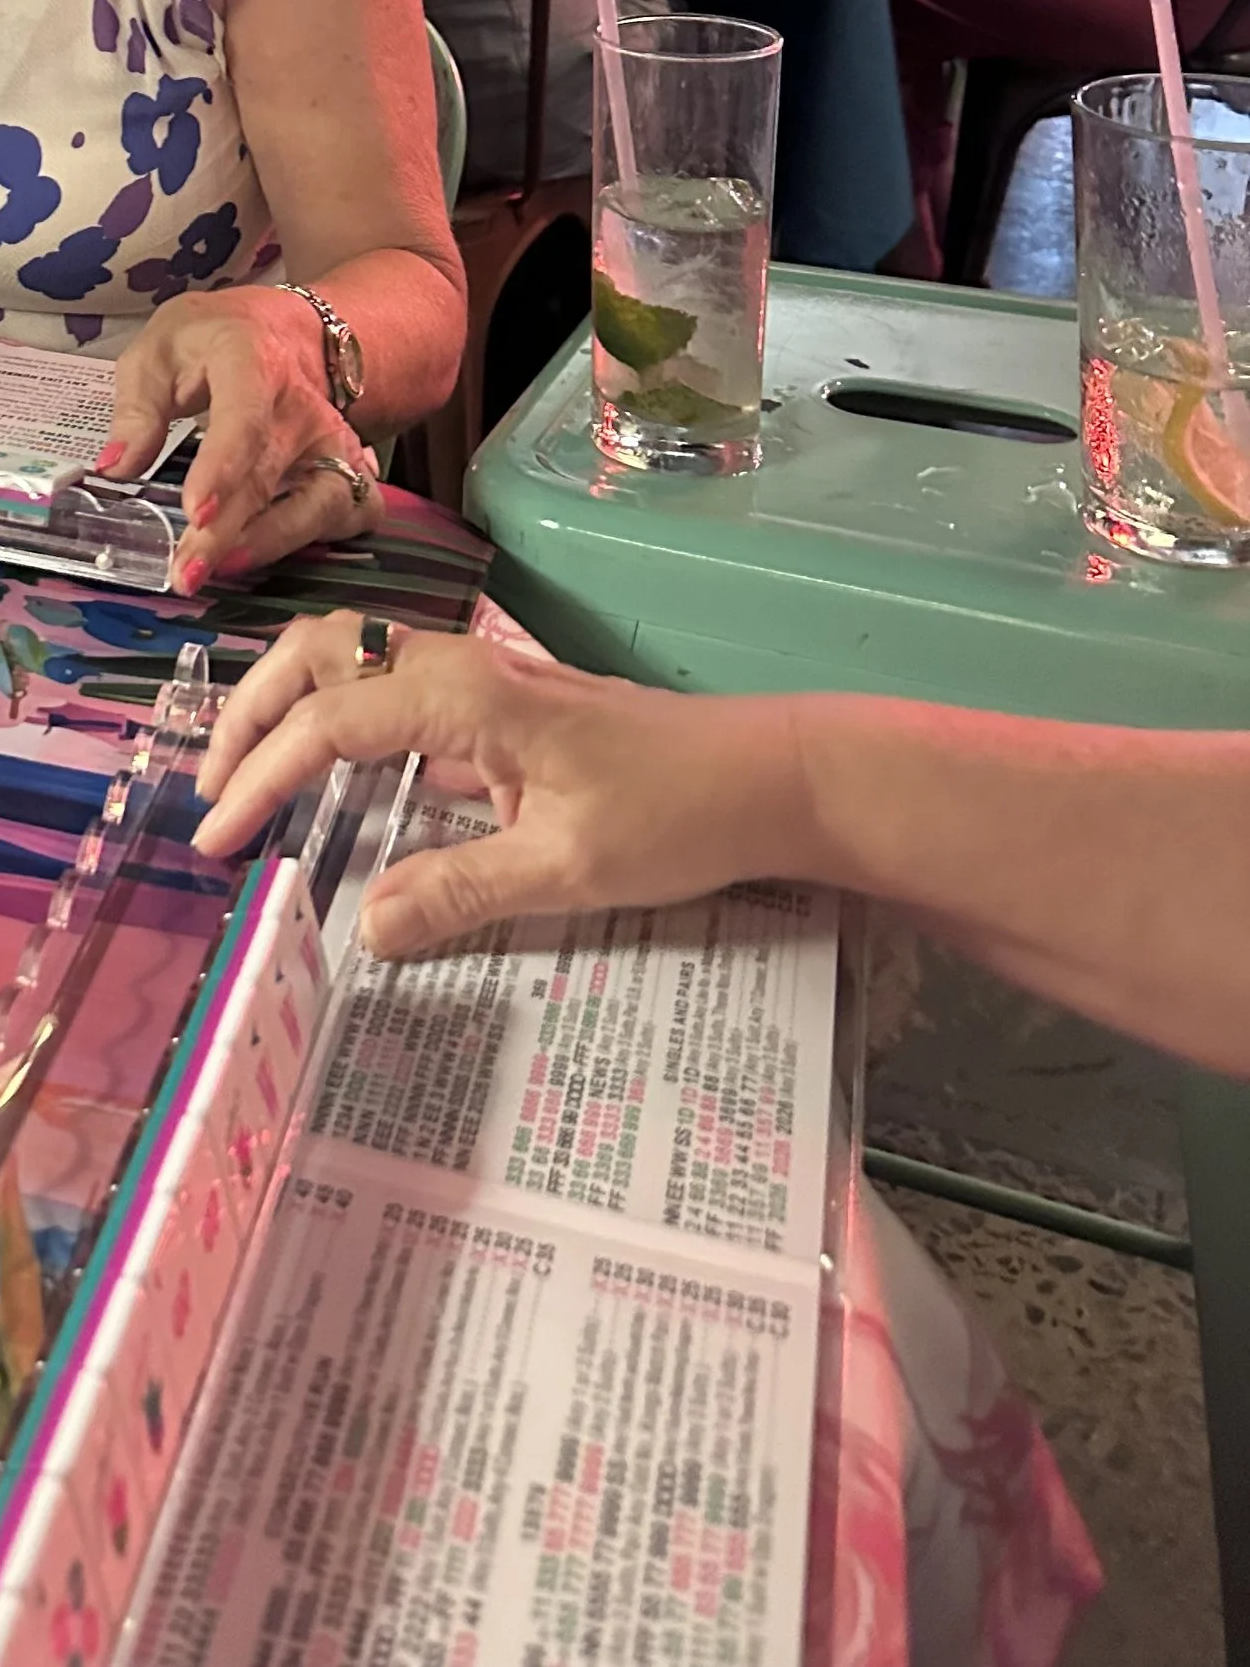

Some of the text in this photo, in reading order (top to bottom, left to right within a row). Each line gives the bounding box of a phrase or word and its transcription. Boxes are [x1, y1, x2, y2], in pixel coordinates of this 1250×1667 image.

[663, 962, 694, 1081] SINGLES AND PAIRS
[589, 1056, 610, 1097] NEWS
